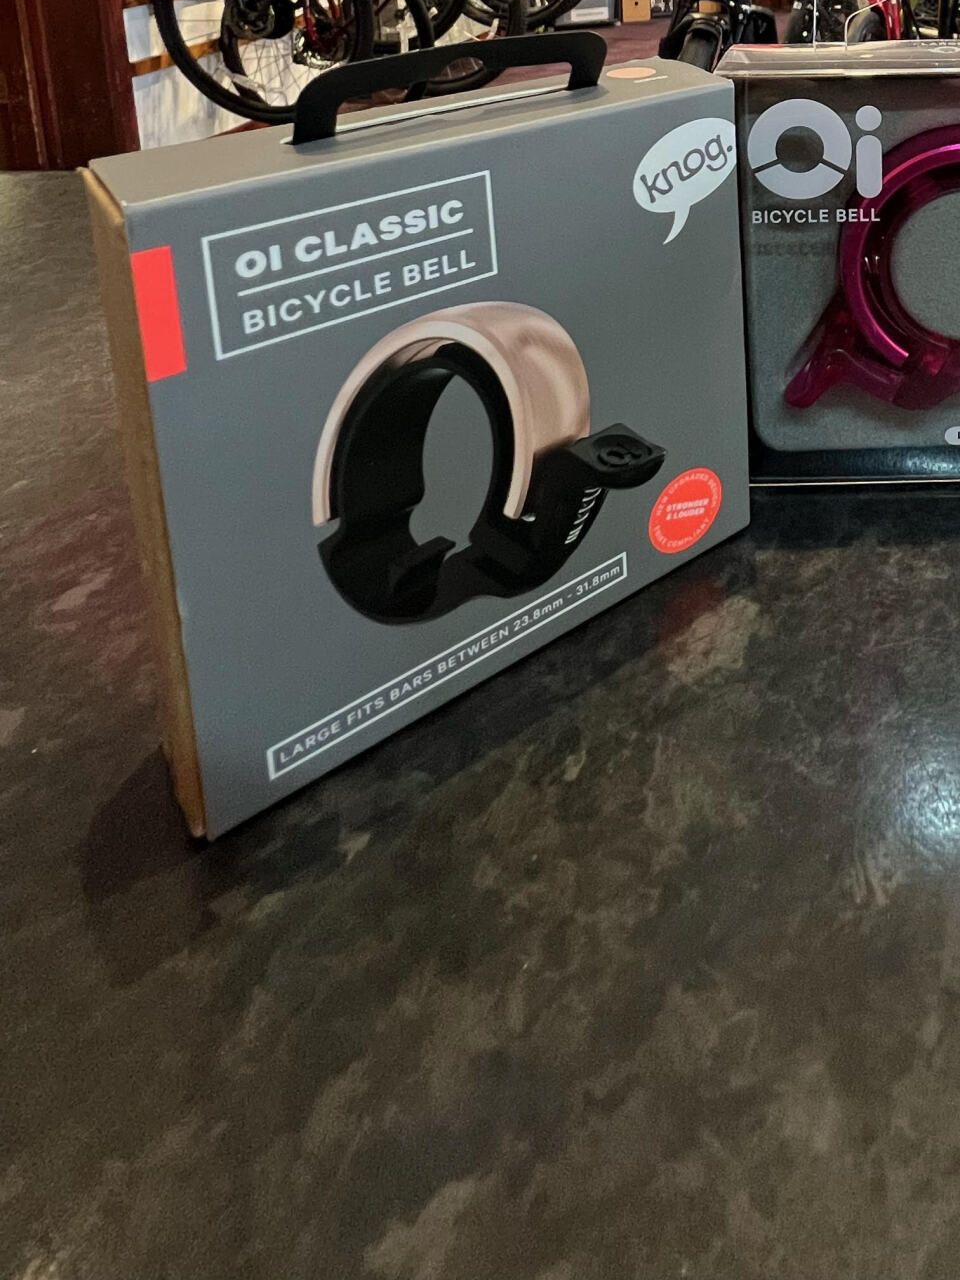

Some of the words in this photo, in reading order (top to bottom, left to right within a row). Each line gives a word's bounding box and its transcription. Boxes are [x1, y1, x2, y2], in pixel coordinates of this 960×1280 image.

[234, 241, 282, 280] OI
[294, 199, 466, 264] CLASSIC
[752, 209, 829, 224] BICYCLE
[835, 208, 880, 223] BELL
[242, 272, 392, 336] BICYCLE
[401, 248, 476, 288] BELL
[666, 498, 710, 513] STRONGER
[673, 507, 705, 520] LOUDER
[279, 721, 342, 764] LARGE
[346, 696, 385, 726] FITS
[389, 669, 433, 703] BARS
[437, 625, 510, 674] BETWEEN
[513, 596, 564, 632] 23.8mm
[575, 564, 621, 596] 31.8mm
